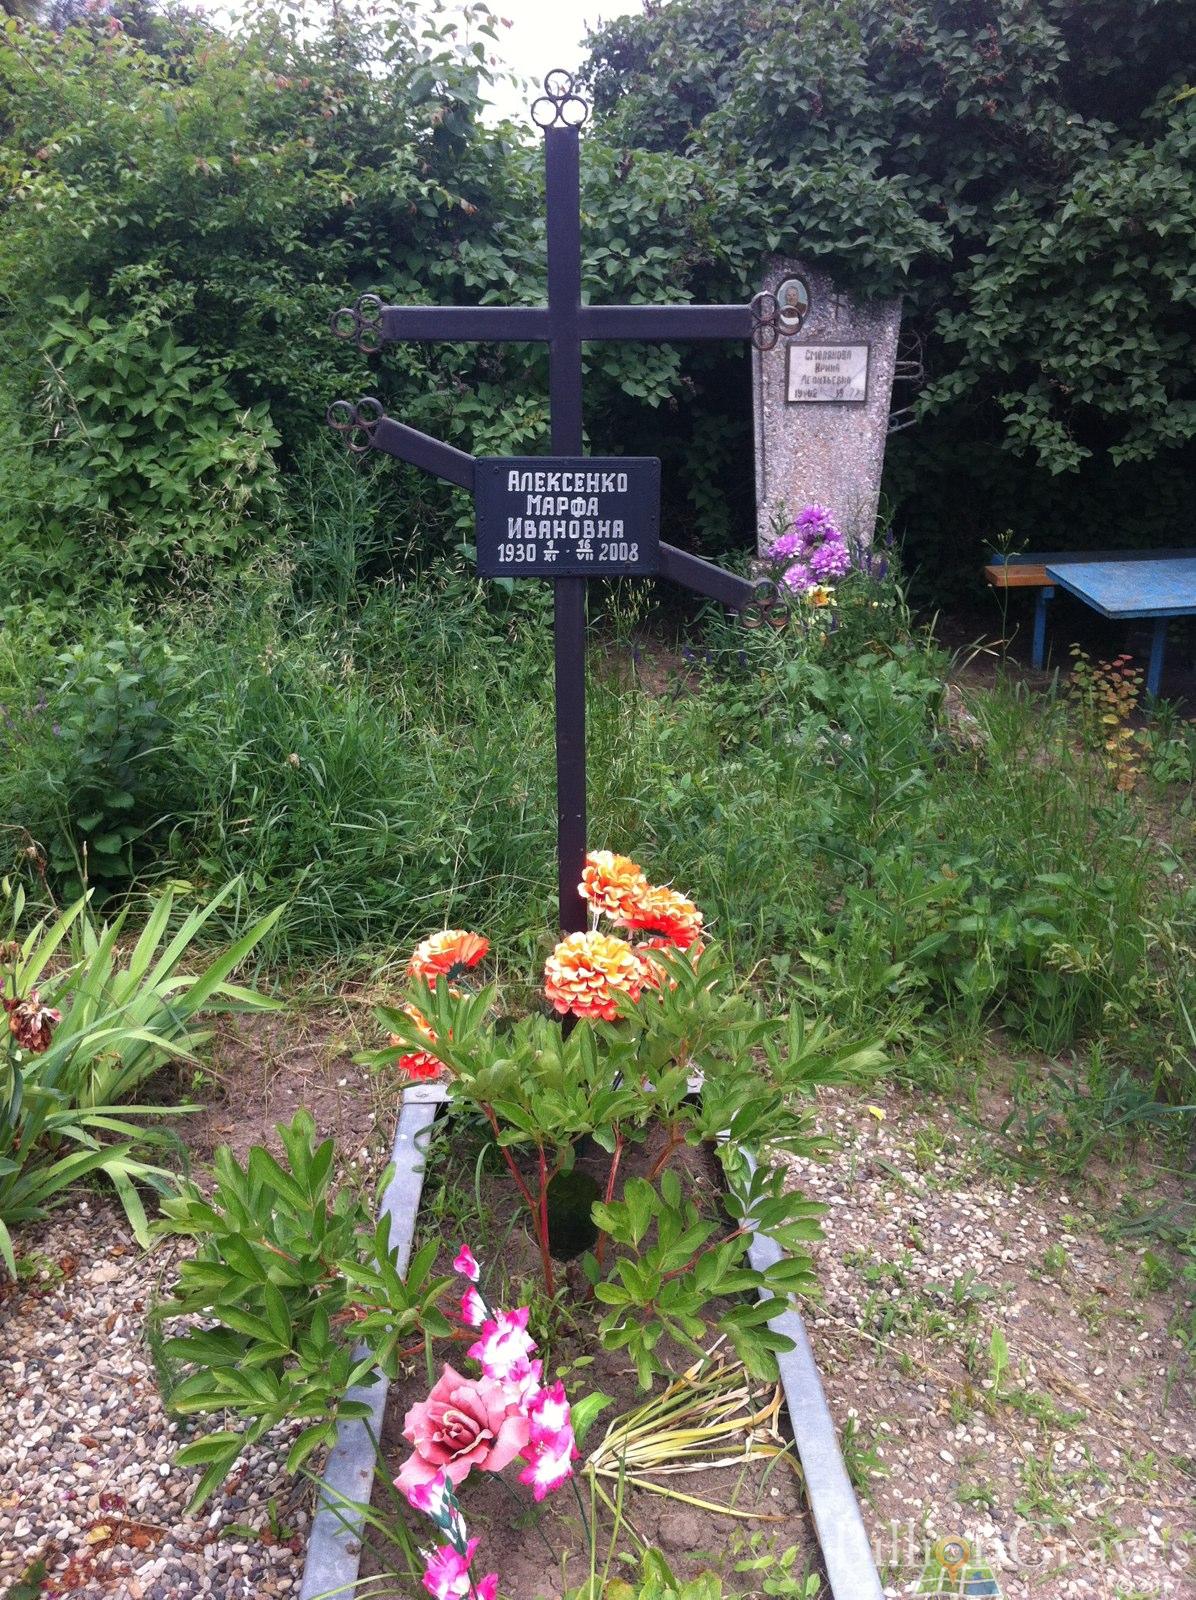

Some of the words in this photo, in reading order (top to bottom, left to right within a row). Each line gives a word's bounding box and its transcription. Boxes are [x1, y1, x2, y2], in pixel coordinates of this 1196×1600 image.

[507, 470, 628, 493] АЛЕКСЕНКО
[526, 494, 599, 518] МАРФА
[507, 517, 624, 539] ИВАНОВНА
[497, 543, 536, 562] 1930
[598, 542, 639, 562] 2008
